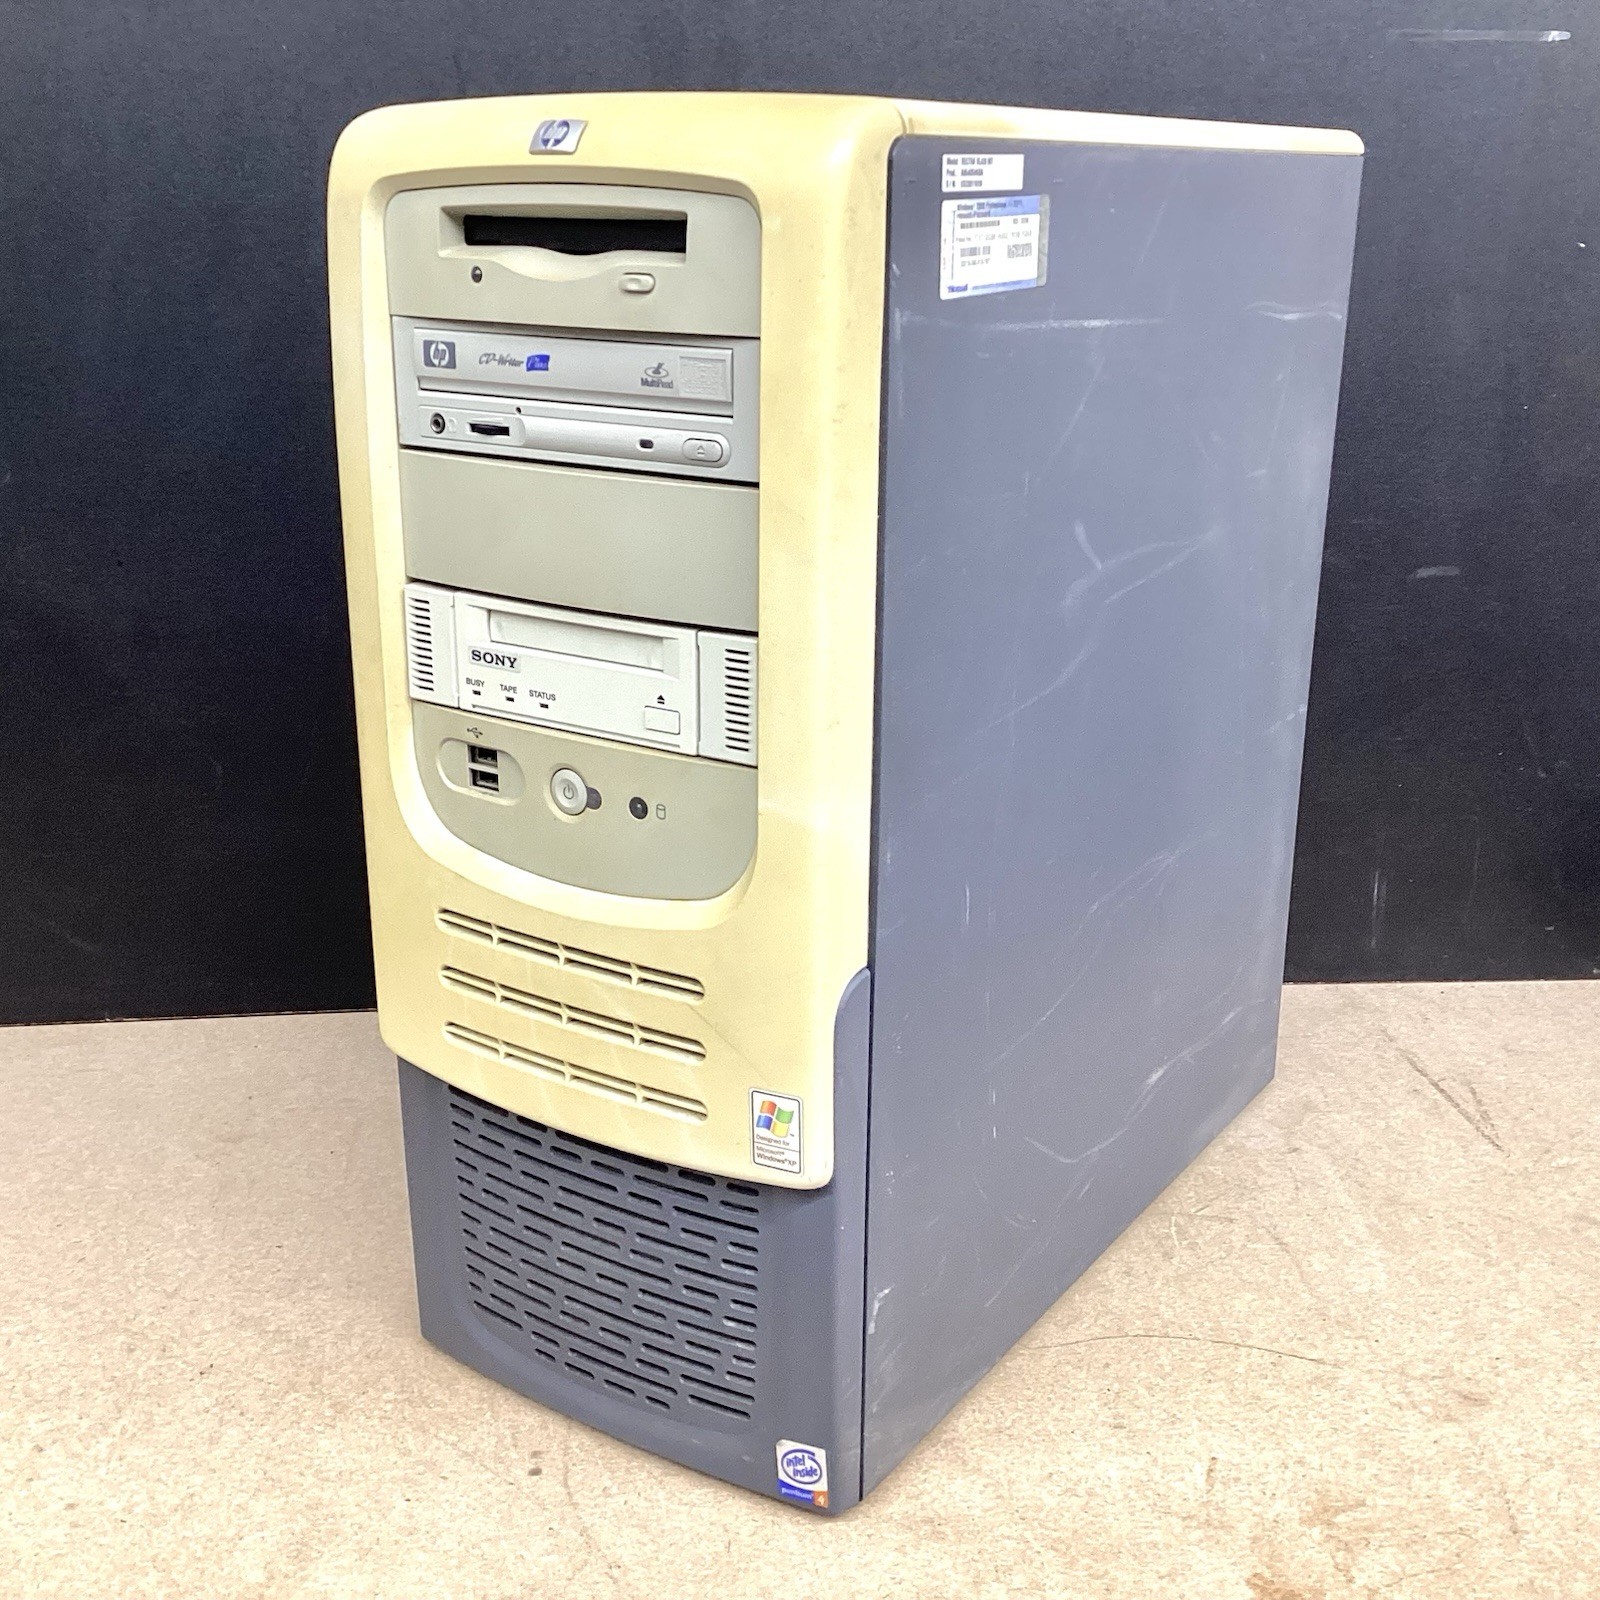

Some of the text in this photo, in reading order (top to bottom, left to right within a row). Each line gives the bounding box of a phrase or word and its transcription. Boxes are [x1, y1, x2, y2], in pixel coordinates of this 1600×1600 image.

[478, 352, 524, 368] CD-Writer
[471, 649, 517, 669] SONY
[465, 677, 485, 687] BUSY
[499, 683, 518, 694] TAPE
[528, 689, 556, 701] STATUS
[756, 1134, 781, 1144] Designed
[786, 1454, 806, 1468] intel
[793, 1466, 818, 1478] inside
[817, 1496, 825, 1505] 4
